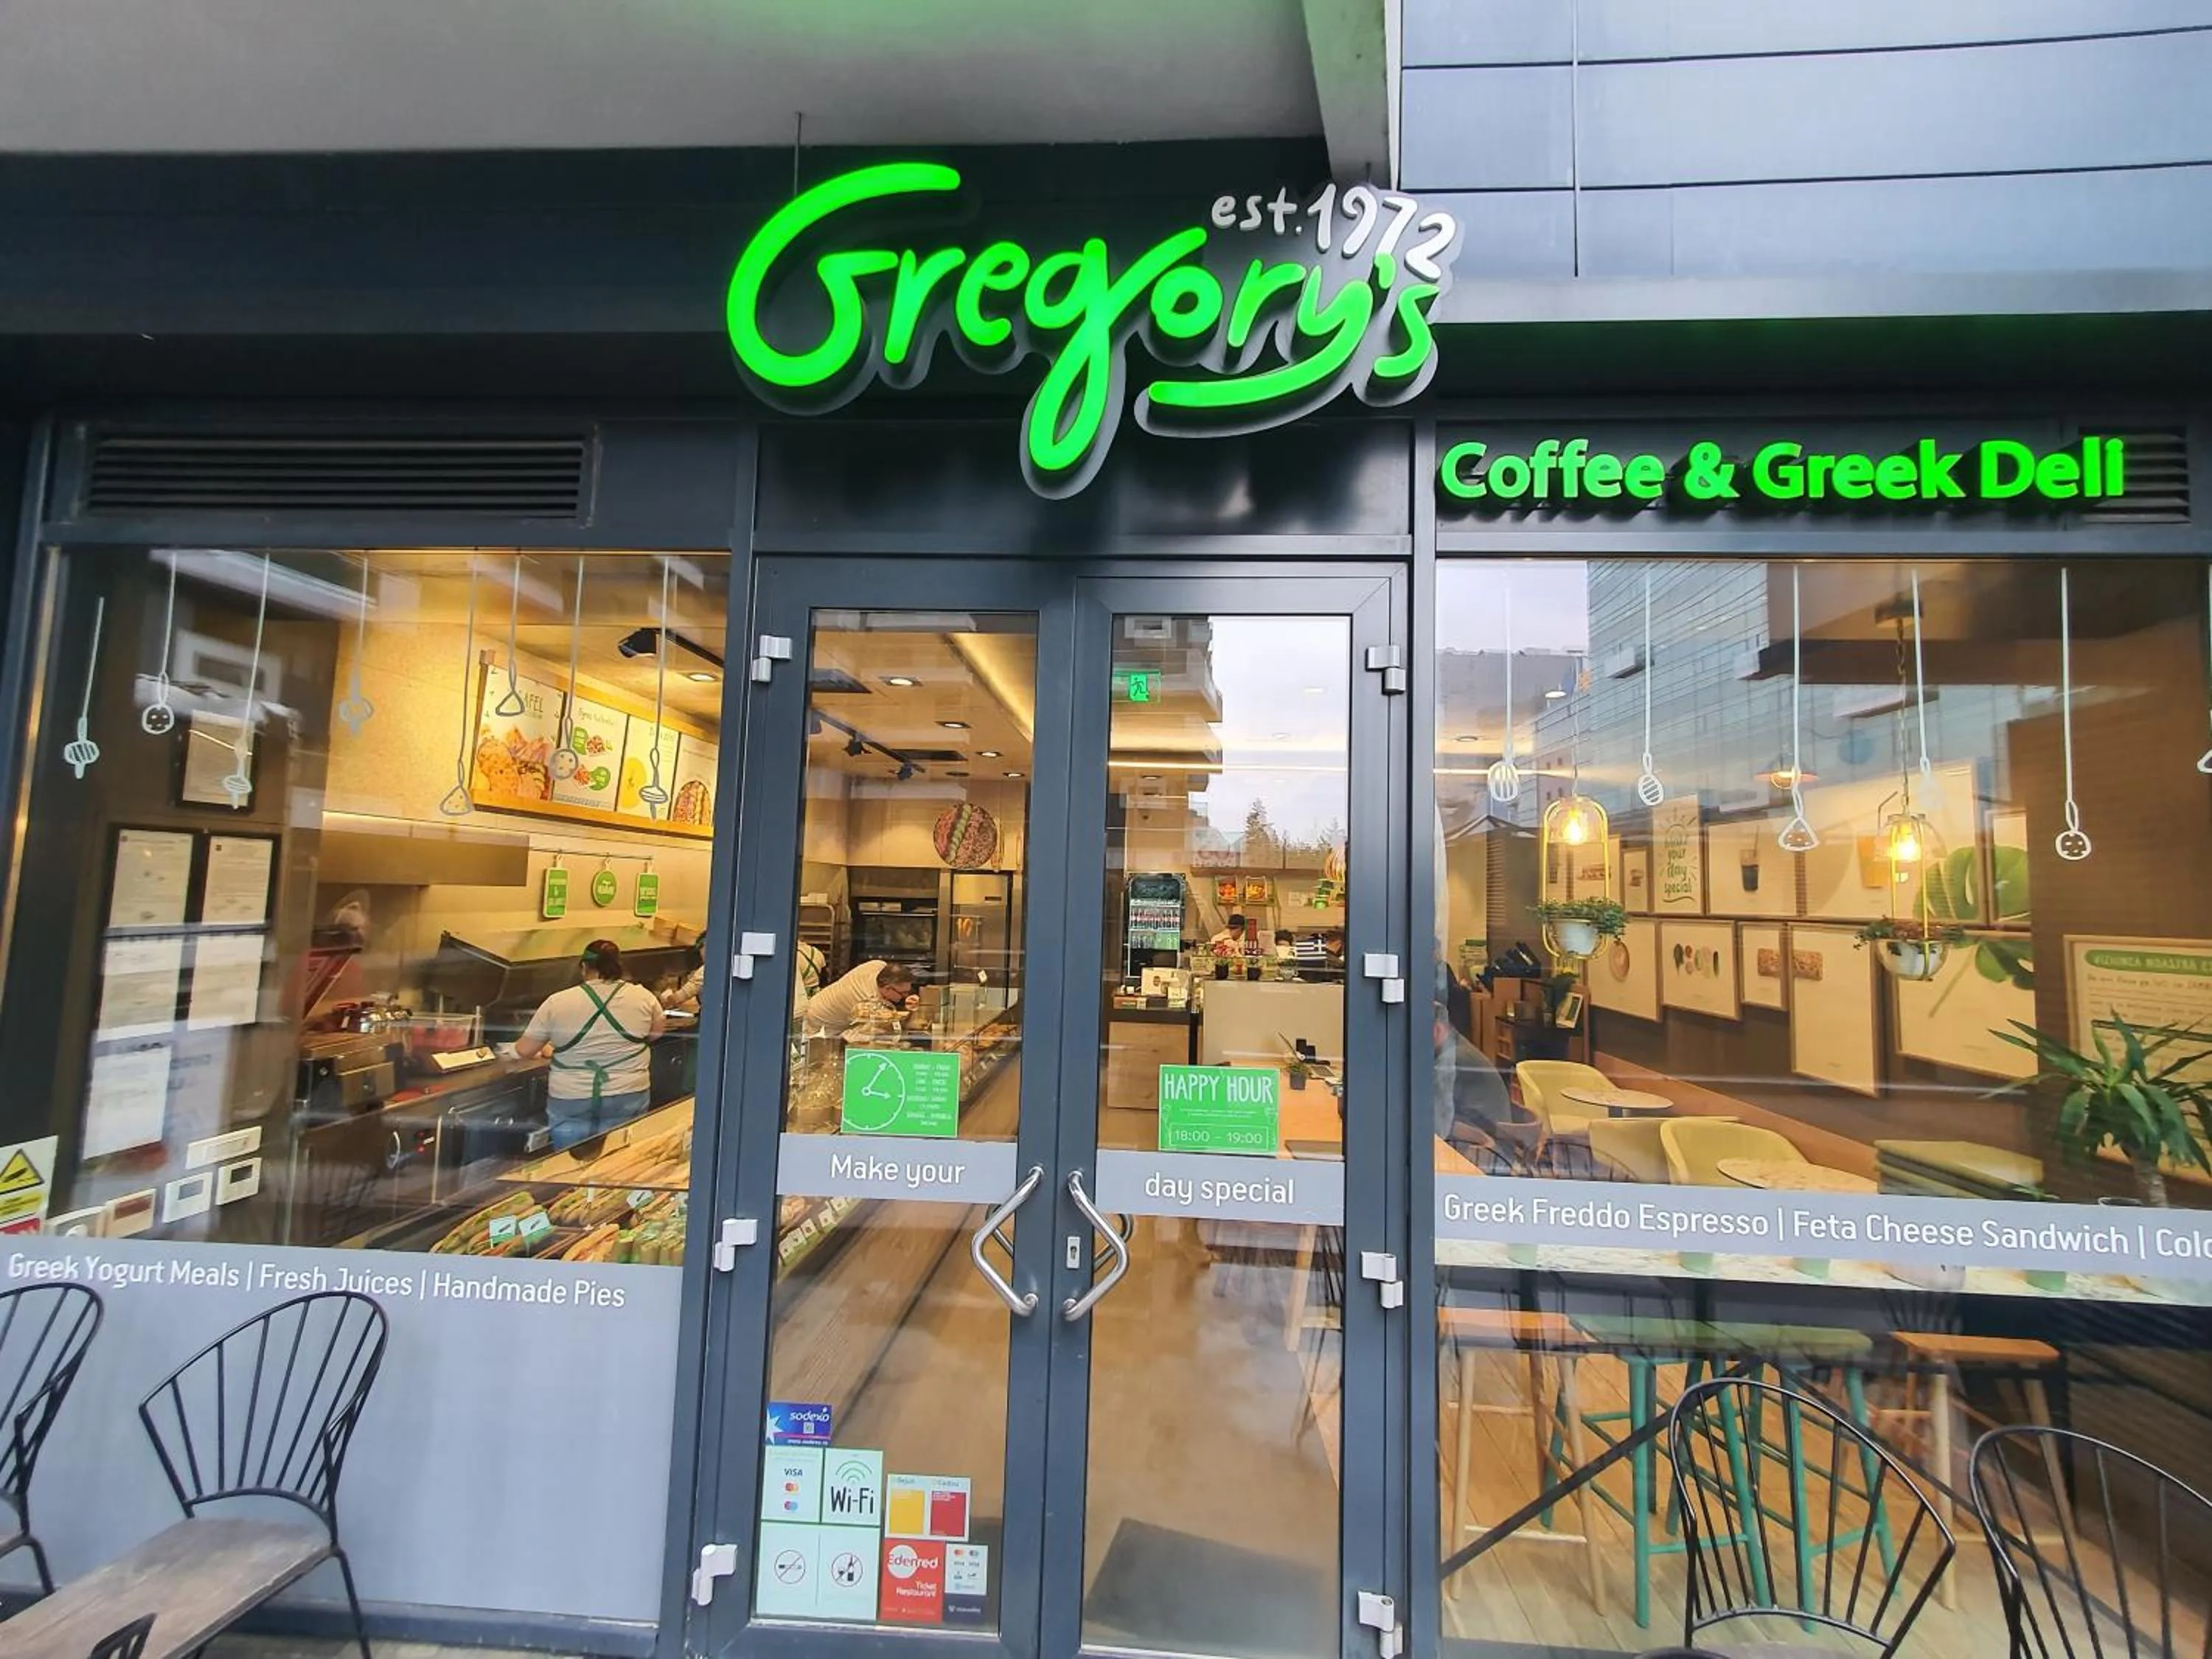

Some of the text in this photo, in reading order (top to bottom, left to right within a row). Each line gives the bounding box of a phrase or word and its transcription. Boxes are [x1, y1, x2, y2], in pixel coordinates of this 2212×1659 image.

[726, 163, 1439, 470] Gregory's
[1439, 436, 2124, 500] Coffee & Greek Deli
[1164, 1073, 1273, 1104] HAPPY HOUR
[1174, 1130, 1210, 1142] 18:00
[1226, 1131, 1263, 1144] 19:00
[831, 1153, 965, 1189] Make your
[1145, 1172, 1294, 1207] day special
[1443, 1193, 1525, 1224] Greek
[1532, 1197, 1630, 1229] Freddo
[1638, 1203, 1768, 1238] Espresso
[1792, 1210, 1857, 1240] Feta
[1865, 1214, 1974, 1247] Cheese
[1982, 1220, 2129, 1254] Sandwich
[8, 1253, 80, 1281] Greek
[85, 1255, 164, 1289] Yogurt
[170, 1259, 240, 1287] Meals
[259, 1263, 327, 1292] Fresh
[334, 1267, 413, 1296] Juices
[433, 1273, 567, 1304] Handmade
[574, 1279, 625, 1307] Pies
[789, 1409, 830, 1422] sodexo
[784, 1468, 804, 1477] VISA
[830, 1486, 874, 1514] Wi-Fi
[888, 1554, 939, 1569] Edenred
